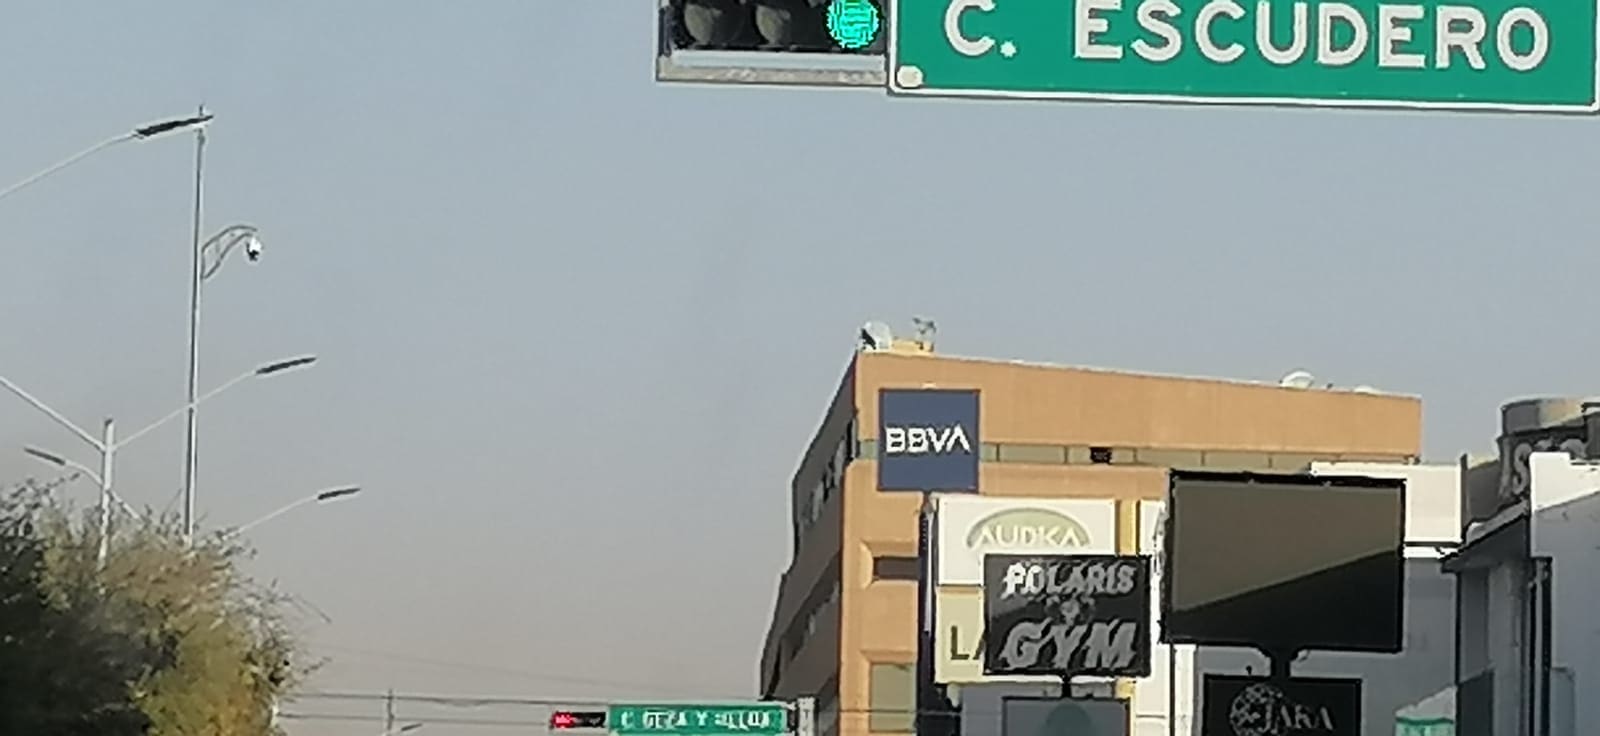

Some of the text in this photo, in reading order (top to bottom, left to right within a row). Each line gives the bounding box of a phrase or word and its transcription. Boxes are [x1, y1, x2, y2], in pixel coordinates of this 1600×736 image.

[943, 0, 1551, 72] C. ESCUDERO
[885, 423, 970, 454] BBVA
[1000, 561, 1137, 599] POLARIS
[999, 617, 1137, 669] GYM
